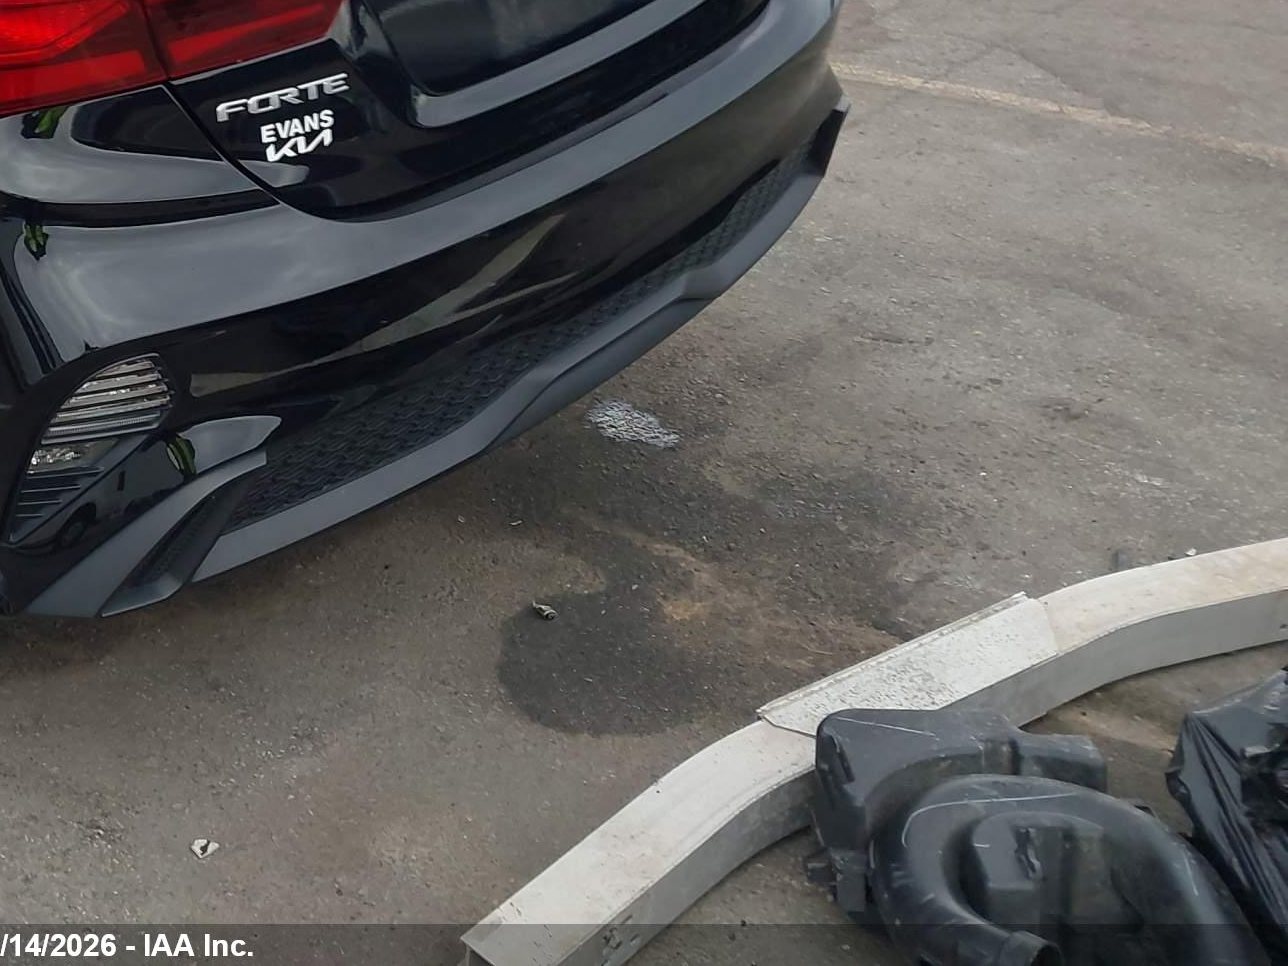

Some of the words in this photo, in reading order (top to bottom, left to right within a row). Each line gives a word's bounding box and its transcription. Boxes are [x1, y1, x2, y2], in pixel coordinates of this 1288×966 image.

[215, 72, 350, 122] FORTE
[260, 109, 335, 143] EVANS
[265, 129, 333, 162] KIA
